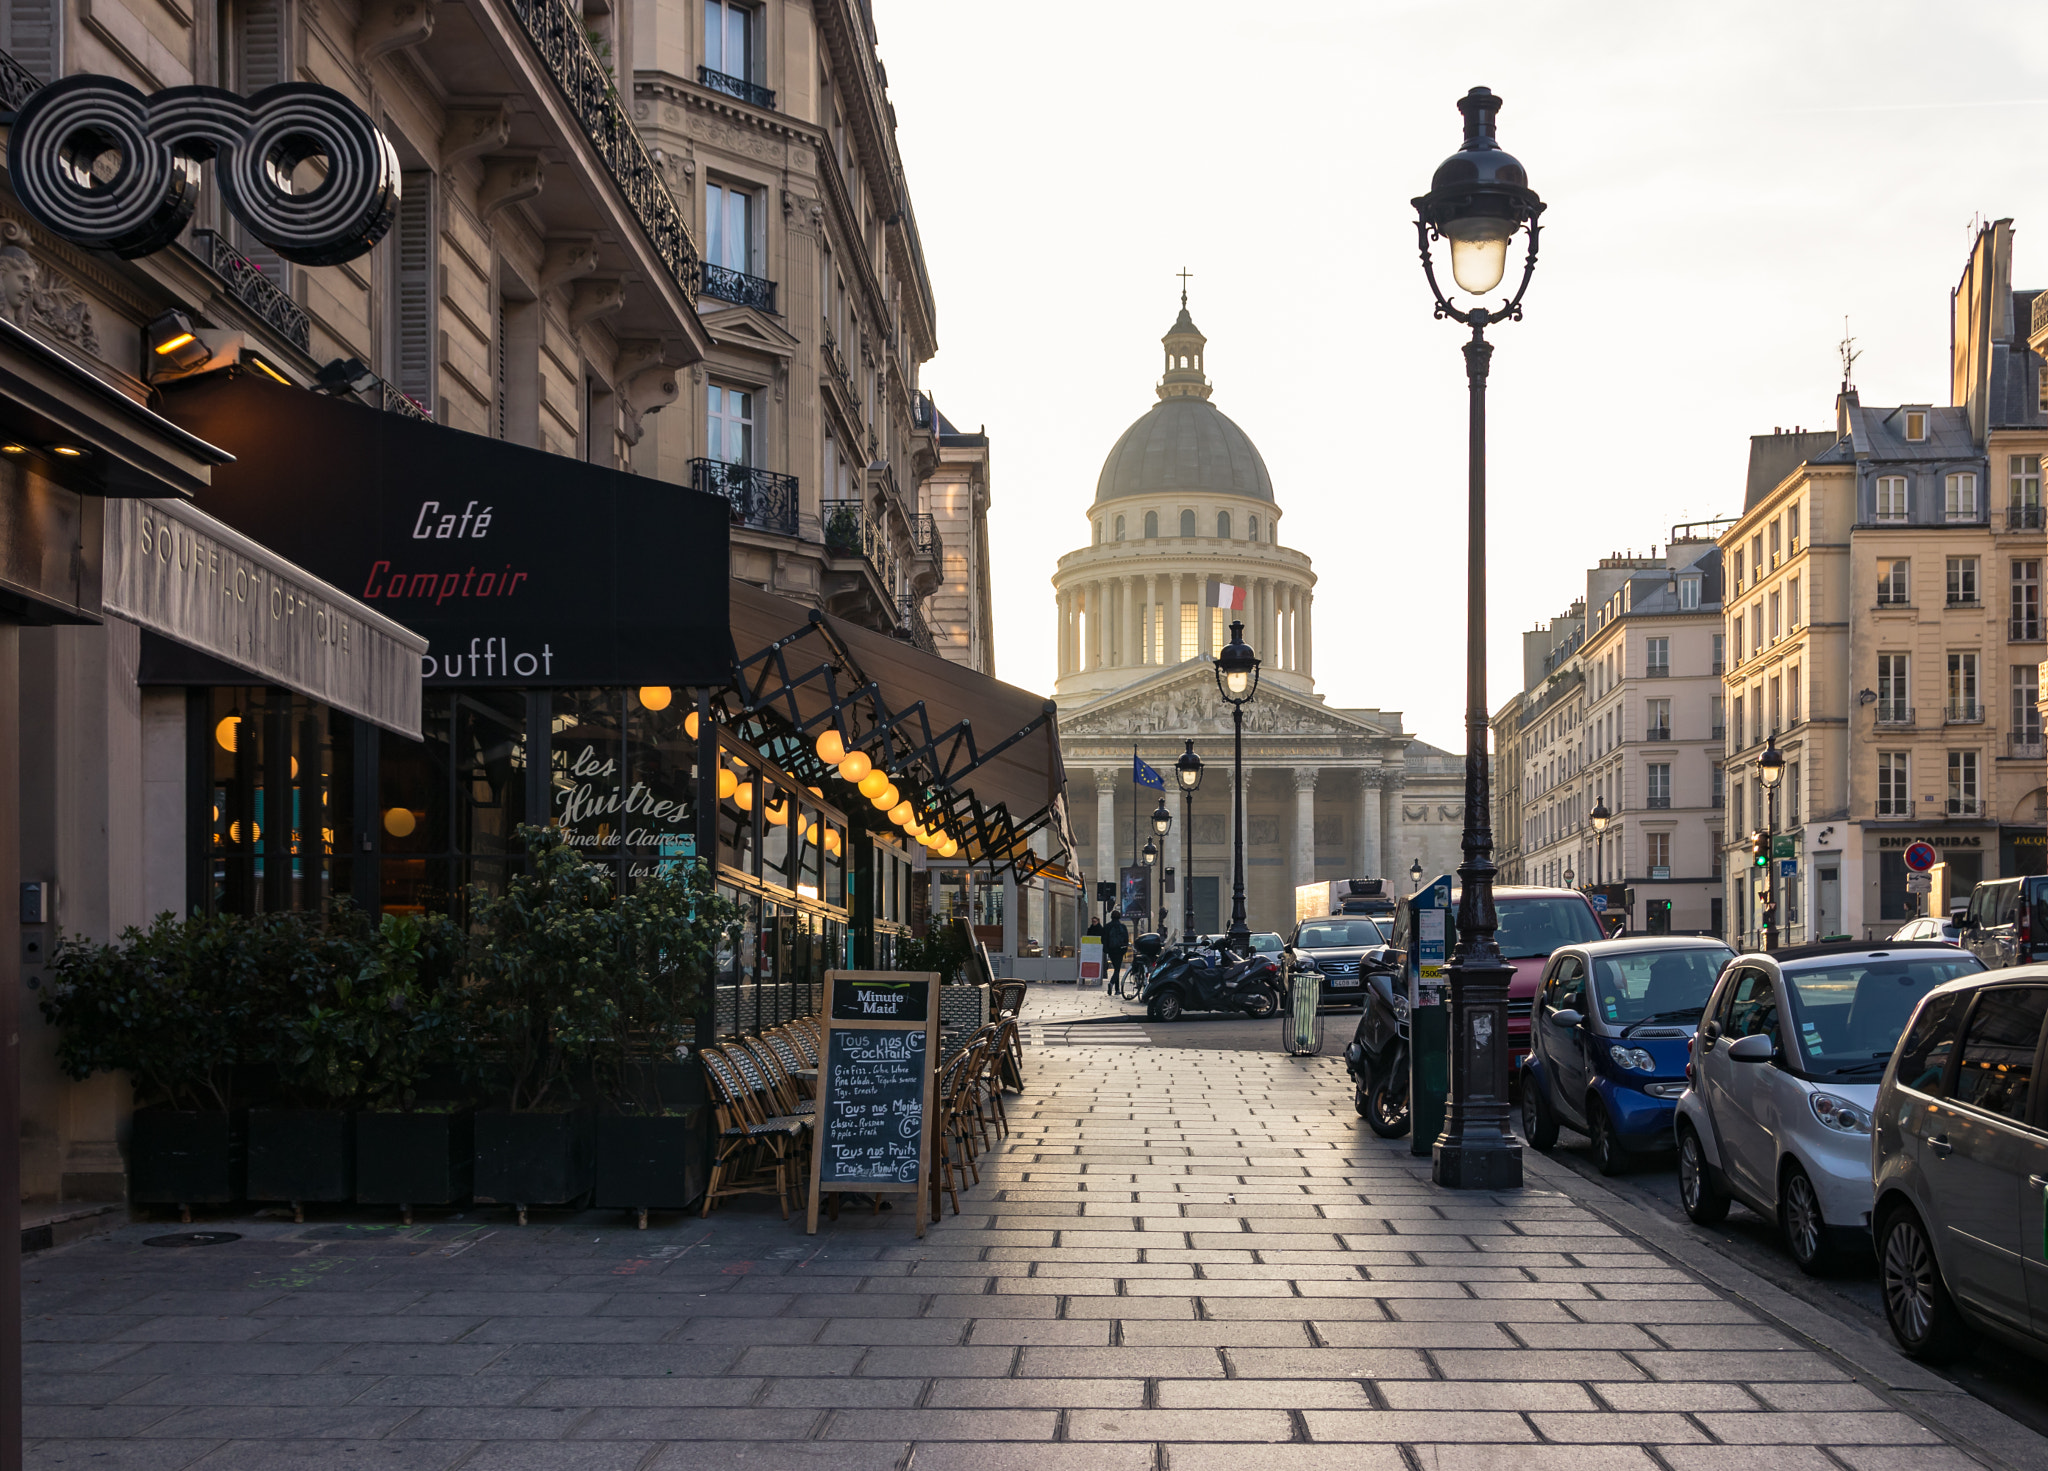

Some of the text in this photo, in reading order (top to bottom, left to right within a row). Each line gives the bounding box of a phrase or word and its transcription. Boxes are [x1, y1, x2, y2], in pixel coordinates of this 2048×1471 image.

[413, 500, 493, 539] Café
[141, 515, 263, 612] SOUFFLOT
[363, 561, 527, 606] Comptoir
[421, 637, 553, 679] oufflot
[570, 744, 617, 777] les
[555, 781, 690, 828] Huitres
[561, 827, 600, 846] Fines
[601, 828, 622, 846] de
[625, 827, 679, 846] Claires
[1880, 837, 1981, 847] BNP PARIBAS
[628, 862, 650, 878] les
[1420, 970, 1442, 978] 7500
[857, 990, 904, 1003] Minute
[862, 1002, 897, 1014] Maid
[835, 1032, 870, 1048] Tous
[880, 1037, 902, 1047] nos
[850, 1045, 911, 1060] cocktails
[833, 1098, 922, 1117] Tous nos Mojitos
[831, 1140, 917, 1158] Tous nos Fruits
